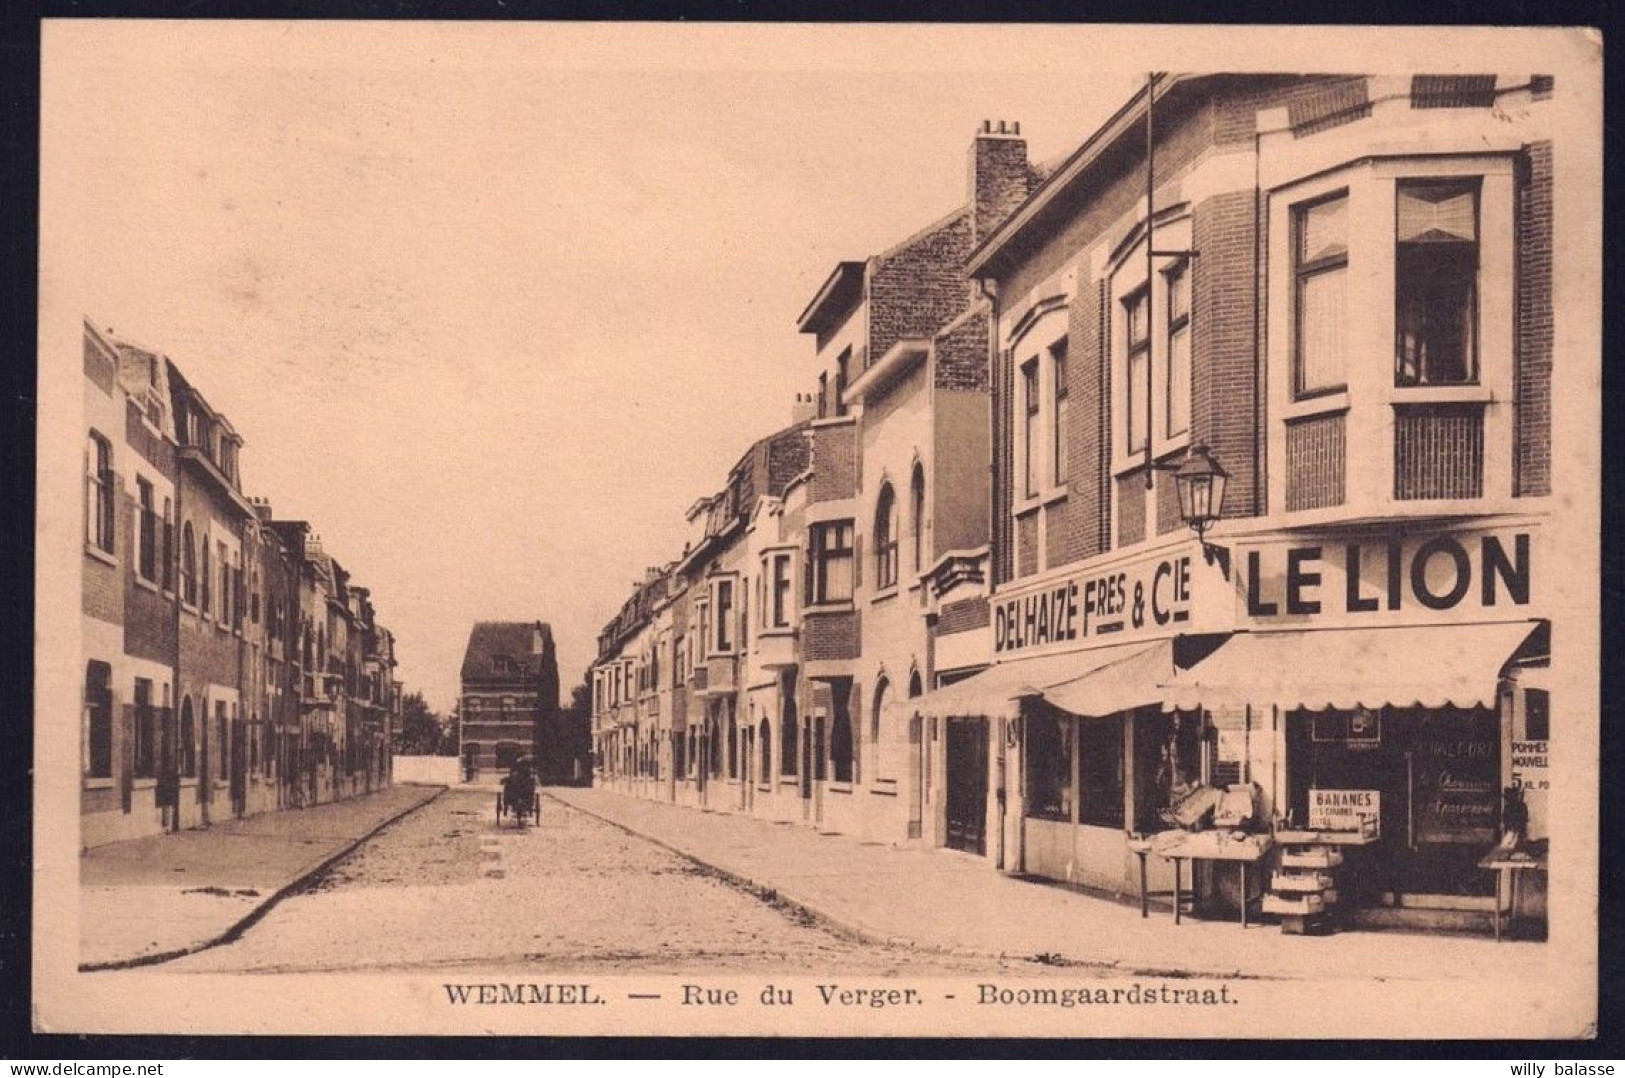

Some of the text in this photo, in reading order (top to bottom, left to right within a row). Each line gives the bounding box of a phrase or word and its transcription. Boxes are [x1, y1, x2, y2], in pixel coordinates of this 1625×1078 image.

[1248, 533, 1530, 617] LE LION
[1132, 579, 1145, 629] &
[1511, 773, 1521, 789] 5
[1316, 793, 1372, 807] BANANES
